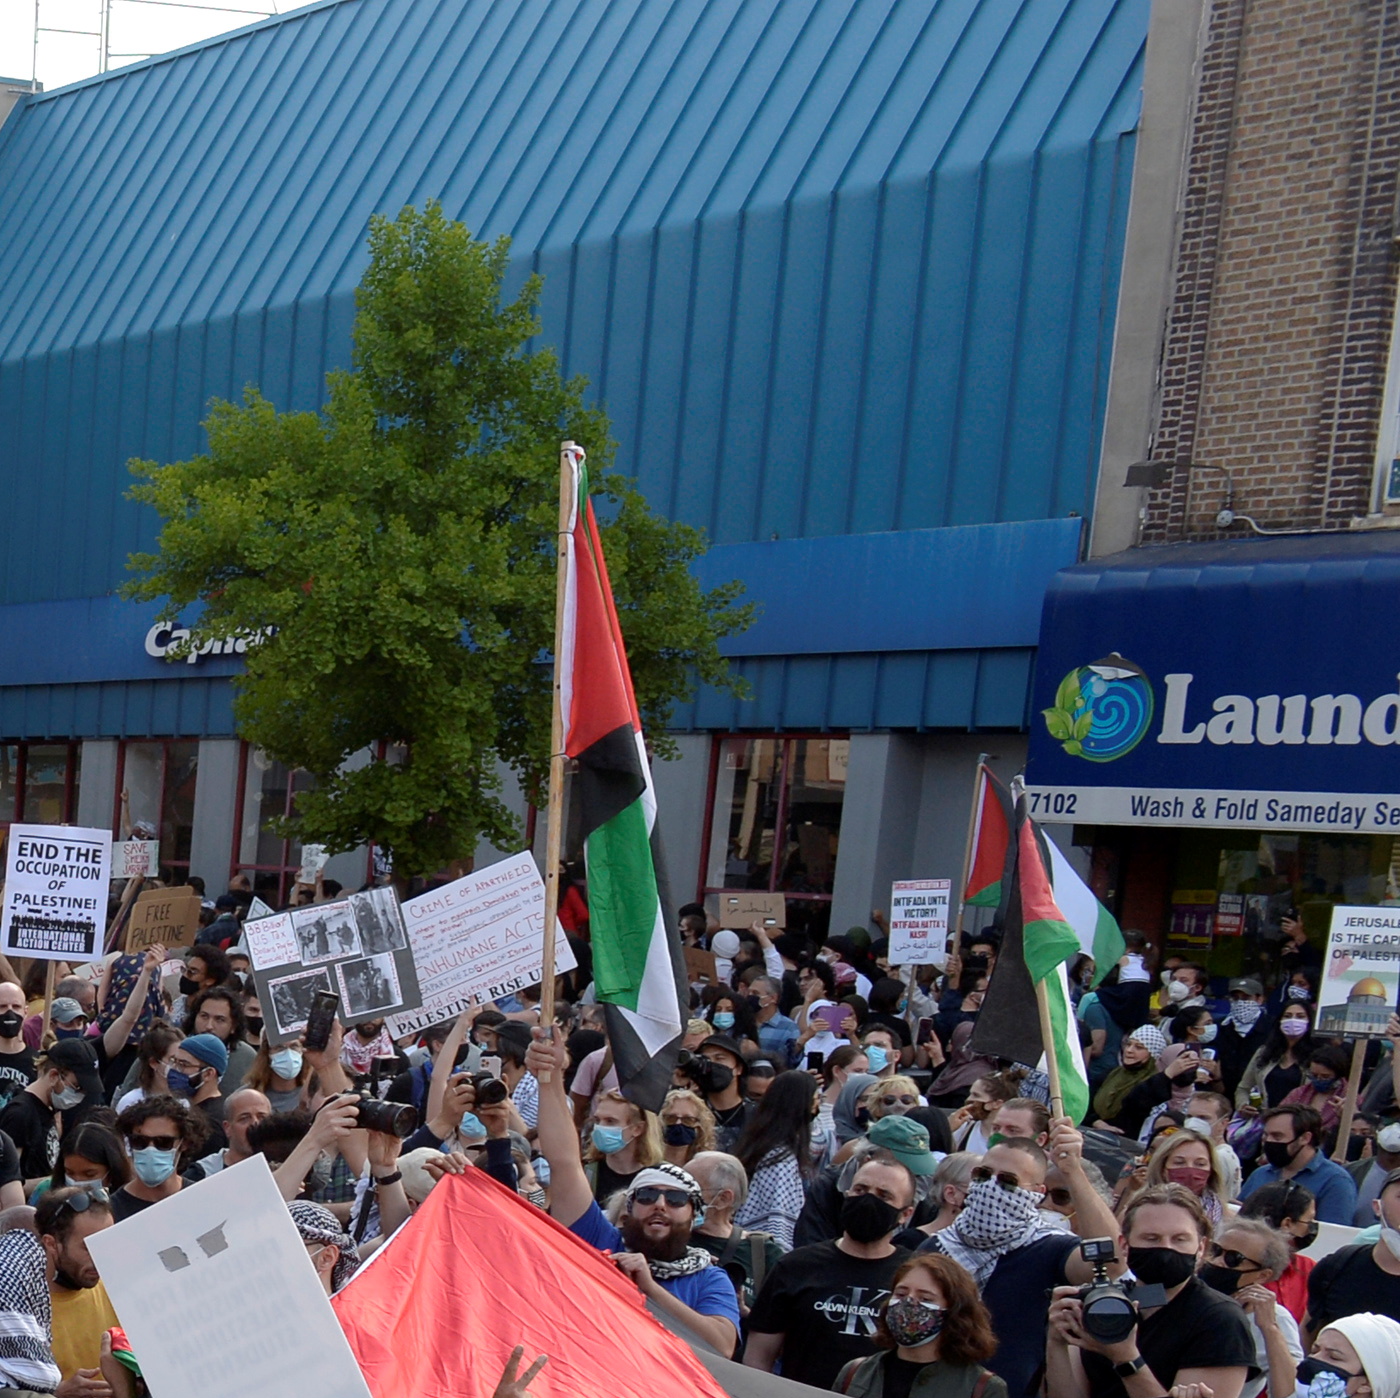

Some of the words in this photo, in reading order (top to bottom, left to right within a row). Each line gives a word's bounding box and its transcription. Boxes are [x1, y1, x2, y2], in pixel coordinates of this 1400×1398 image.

[1157, 672, 1400, 746] Laund
[1030, 793, 1077, 814] 7102
[1131, 795, 1184, 819] Wash
[1192, 797, 1207, 818] &
[1214, 798, 1258, 821] Fold
[1265, 799, 1367, 830] Sameday
[1374, 802, 1400, 826] Se
[17, 841, 59, 860] END
[63, 845, 103, 865] THE
[123, 843, 148, 855] SAVE
[15, 859, 101, 881] OCCUPATION
[47, 879, 67, 891] OF
[409, 895, 455, 919] CRIME
[459, 887, 471, 897] OF
[475, 864, 531, 892] APARTHEID
[13, 893, 97, 910] PALESTINE!
[893, 896, 926, 907] INTIFADA
[927, 896, 947, 906] UNTIL
[145, 903, 172, 923] FREE
[903, 908, 938, 918] VICTORY!
[504, 912, 545, 943] ACTS
[1344, 917, 1400, 928] JERUSALE
[17, 928, 86, 943] INTERNATIONAL
[131, 925, 185, 948] PALESTINE
[1331, 933, 1344, 943] IS
[1346, 933, 1370, 944] THE
[1372, 934, 1400, 945] CAPI
[16, 938, 50, 949] ACTION
[51, 940, 86, 953] CENTER
[507, 944, 533, 958] Israel
[1332, 949, 1350, 959] OF
[1352, 950, 1400, 961] PALESTI
[413, 998, 443, 1015] World
[461, 967, 512, 997] Witnessing
[514, 960, 542, 974] Genoc
[396, 991, 485, 1035] PALESTINE
[488, 977, 526, 999] RISE
[814, 1301, 847, 1313] CALVIN
[848, 1305, 875, 1317] KLEIN
